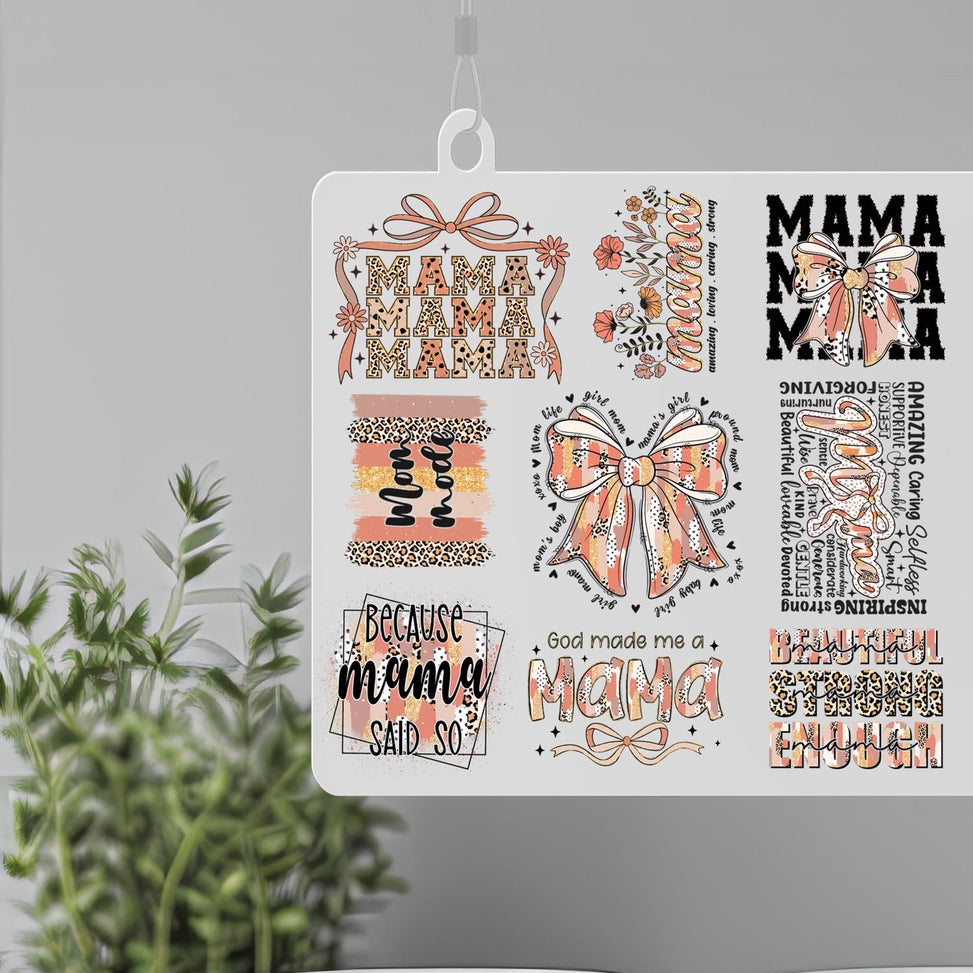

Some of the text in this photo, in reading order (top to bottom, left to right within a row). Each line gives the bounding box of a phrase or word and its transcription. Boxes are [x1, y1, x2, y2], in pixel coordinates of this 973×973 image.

[766, 194, 946, 247] MAMA
[365, 255, 536, 295] MAMA
[665, 192, 703, 373] mama
[708, 199, 718, 373] amazing loving caring strong
[365, 297, 536, 337] MAMA
[365, 338, 536, 379] MAMA
[583, 390, 607, 407] girl
[779, 381, 877, 395] FORGIVING
[780, 398, 832, 408] nurturing
[530, 405, 563, 454] Mom life
[637, 392, 690, 450] mama's girl
[878, 382, 891, 440] HONEST
[798, 433, 816, 465] Wise
[379, 428, 424, 526] Mom
[420, 427, 456, 527] mode
[532, 473, 546, 501] xoxo
[904, 381, 928, 596] AMAZING Caring Selfless
[779, 411, 801, 598] Beautiful loveable Devoted
[794, 490, 805, 519] KIND
[806, 485, 820, 518] Brave
[532, 512, 568, 573] mom's boy
[711, 518, 726, 537] life
[726, 557, 744, 585] xoxo
[795, 539, 811, 598] GENTLE
[882, 540, 903, 595] Smart
[566, 568, 618, 611] girl mama
[653, 578, 702, 618] baby girl
[780, 599, 928, 615] INSPIRING strong
[547, 631, 705, 649] God made me a
[768, 628, 944, 665] BEAUTIFUL
[338, 657, 491, 704] mama
[768, 669, 944, 718] STRONG
[369, 720, 462, 756] SAID SO
[768, 722, 944, 769] ENOUGH
